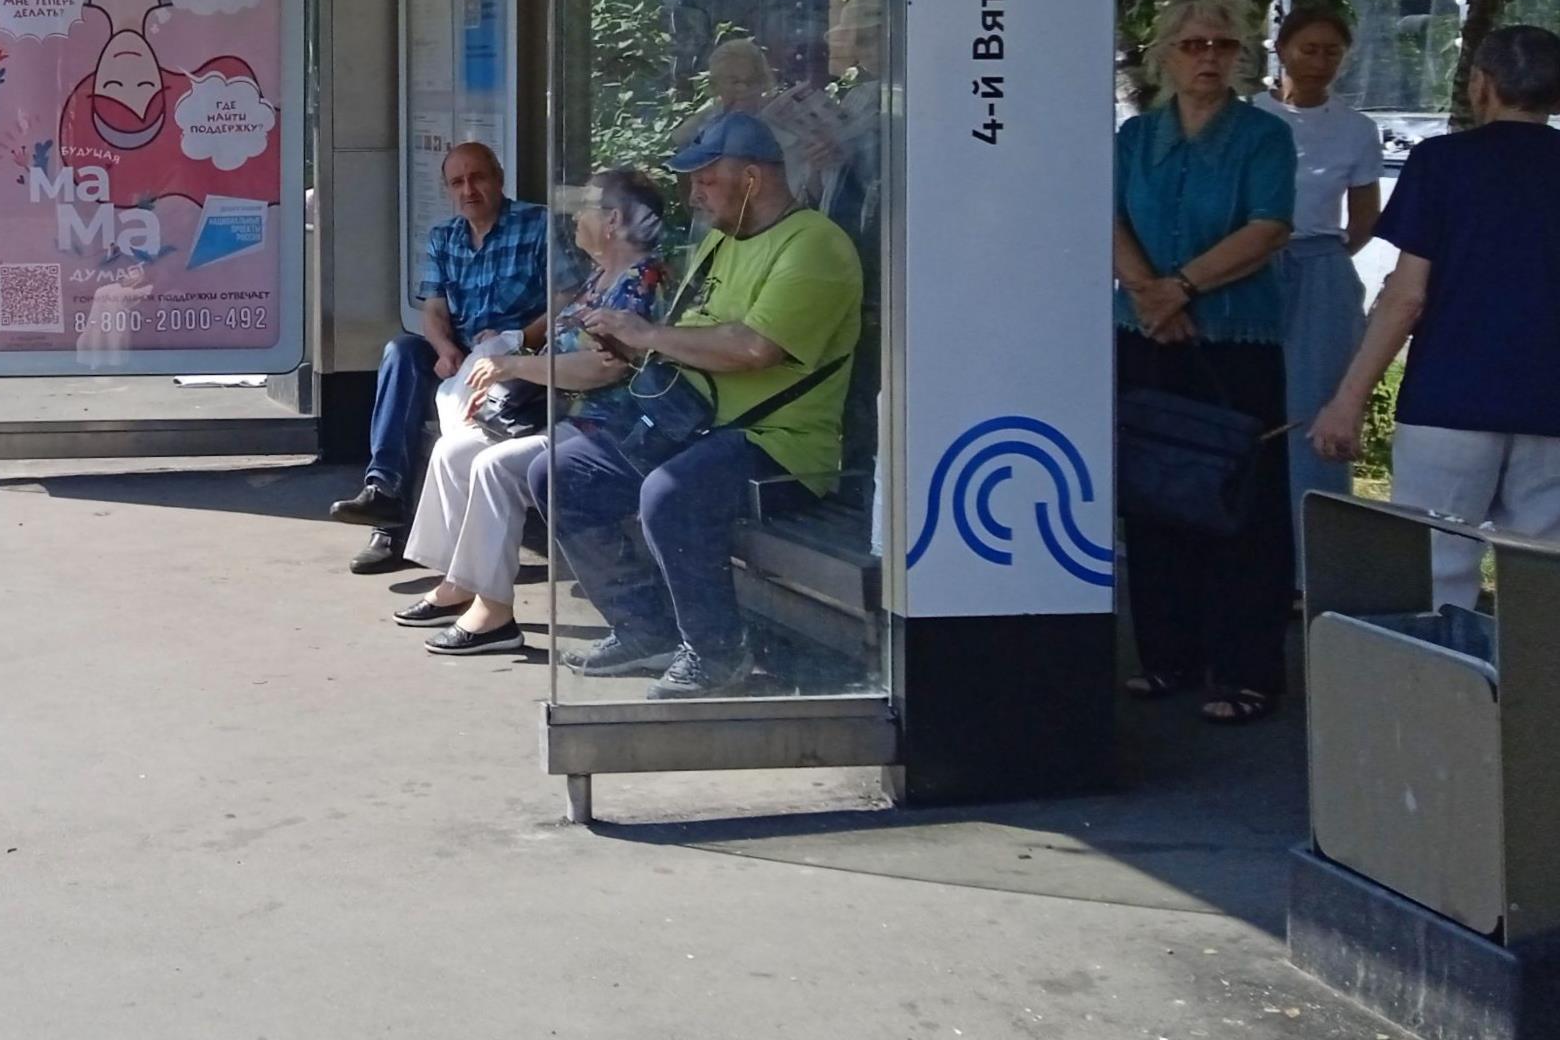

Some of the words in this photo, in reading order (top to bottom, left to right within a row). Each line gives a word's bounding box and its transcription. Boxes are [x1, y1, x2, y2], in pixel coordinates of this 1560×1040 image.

[13, 9, 65, 18] ДЕЛАТЬ?
[216, 101, 236, 110] ГДЕ
[972, 76, 1004, 145] 4-й
[190, 124, 263, 134] ПОДДЕРЖКУ?
[220, 291, 270, 300] ОТВЕЧАЕТ
[73, 306, 267, 333] 8-800-2000-492
